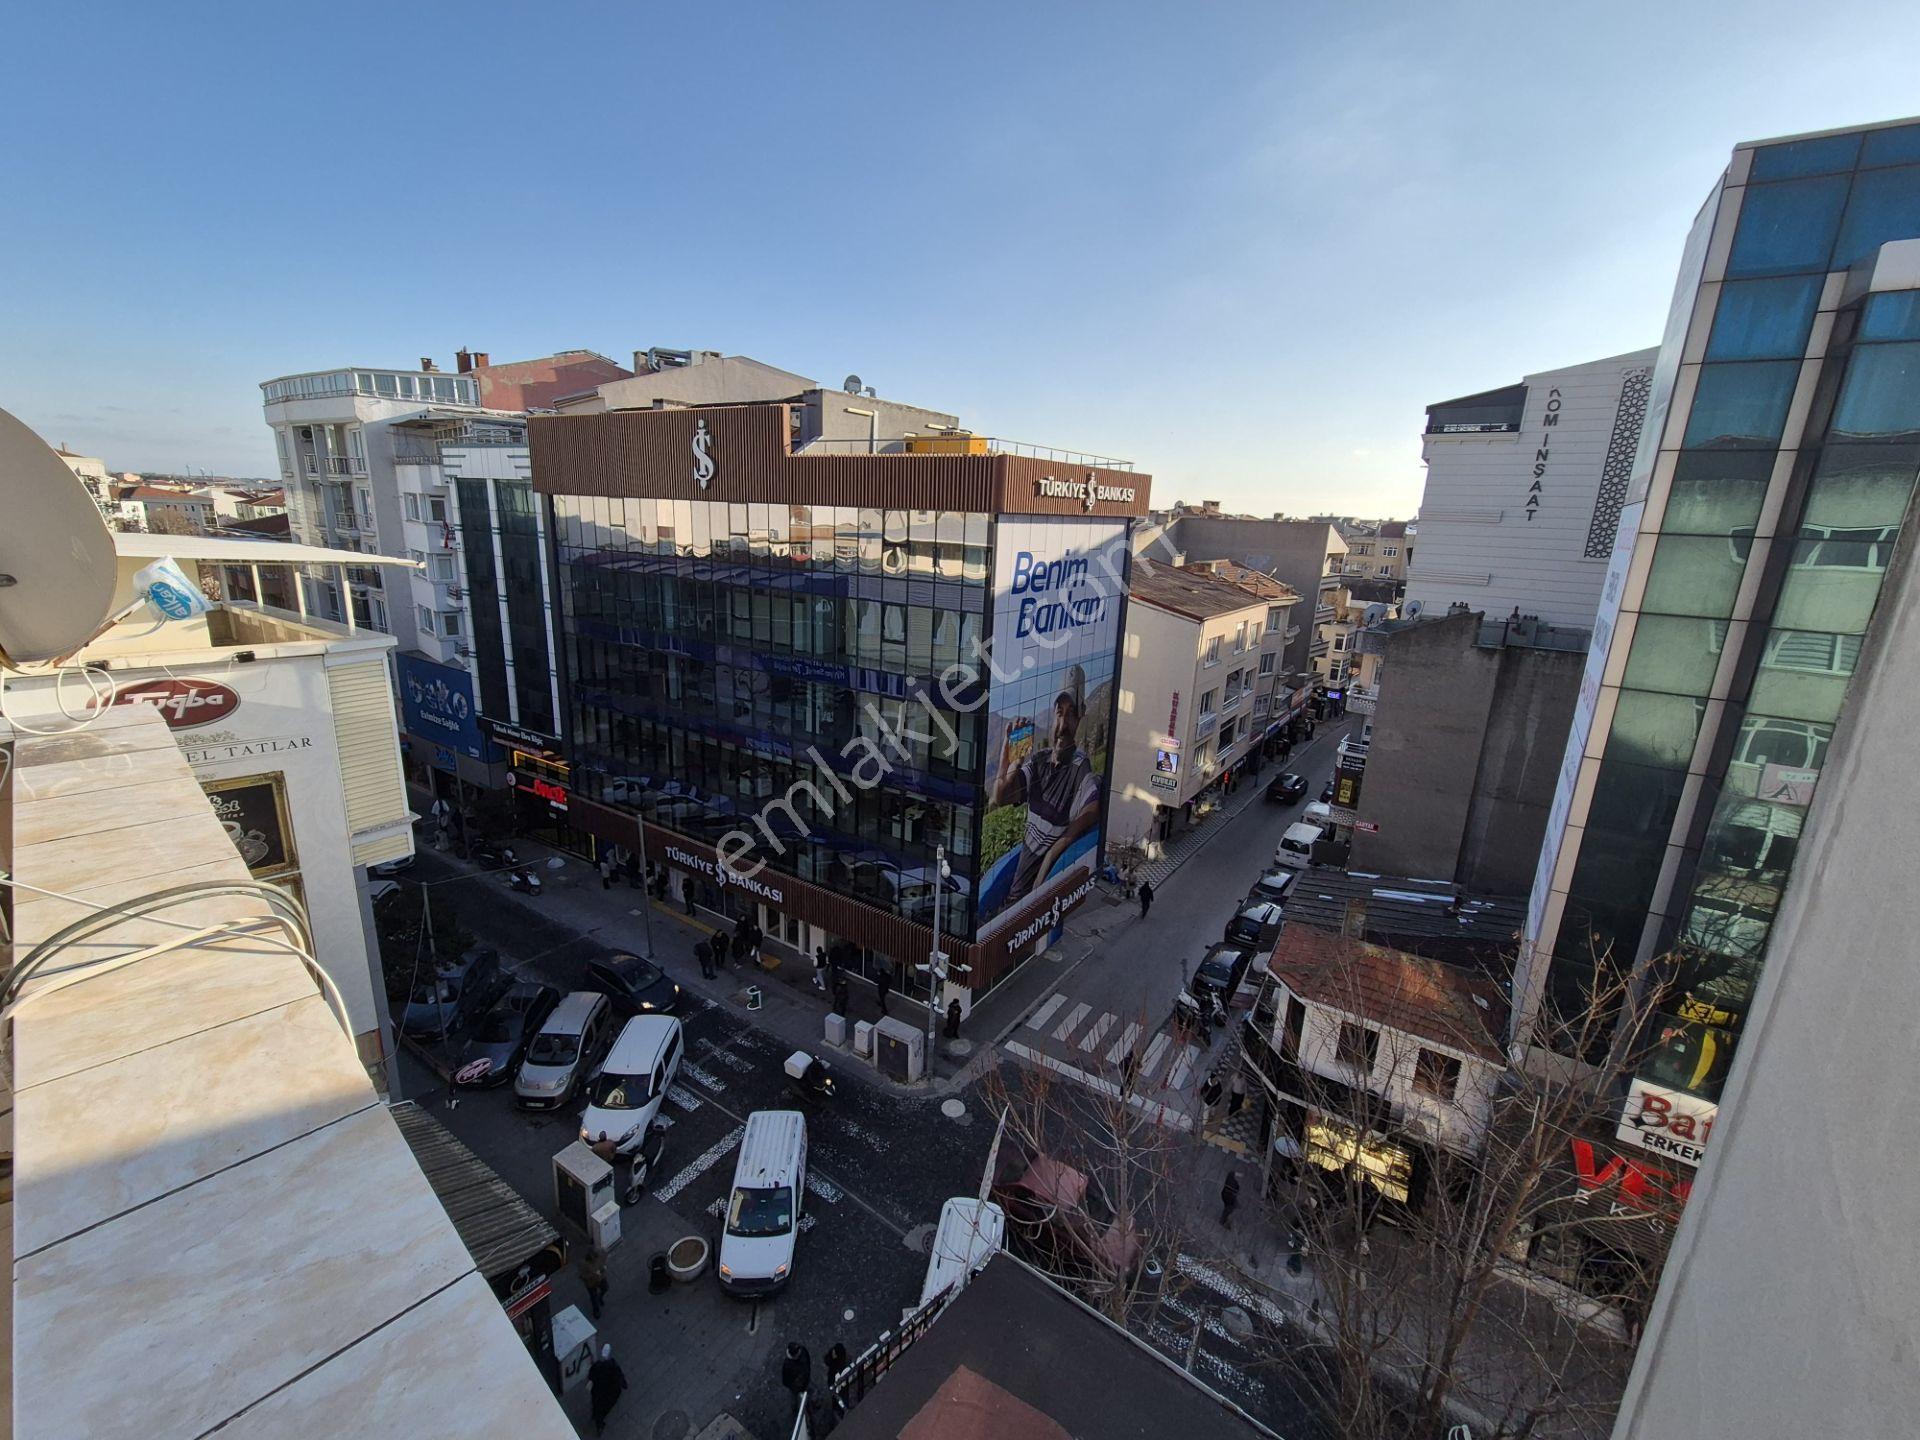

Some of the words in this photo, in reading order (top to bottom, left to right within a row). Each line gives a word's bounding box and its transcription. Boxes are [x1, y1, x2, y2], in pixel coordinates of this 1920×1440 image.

[1039, 476, 1087, 499] TÜRKİYE
[1097, 485, 1136, 502] BANKASI
[1011, 549, 1089, 595] Benim
[1016, 597, 1106, 639] Bankam
[224, 736, 313, 758] TATLAR
[664, 845, 714, 876] TÜRKİYE
[728, 871, 783, 904] BANKASI
[1007, 911, 1051, 954] TÜRKİYE
[1061, 875, 1097, 912] BANKAS
